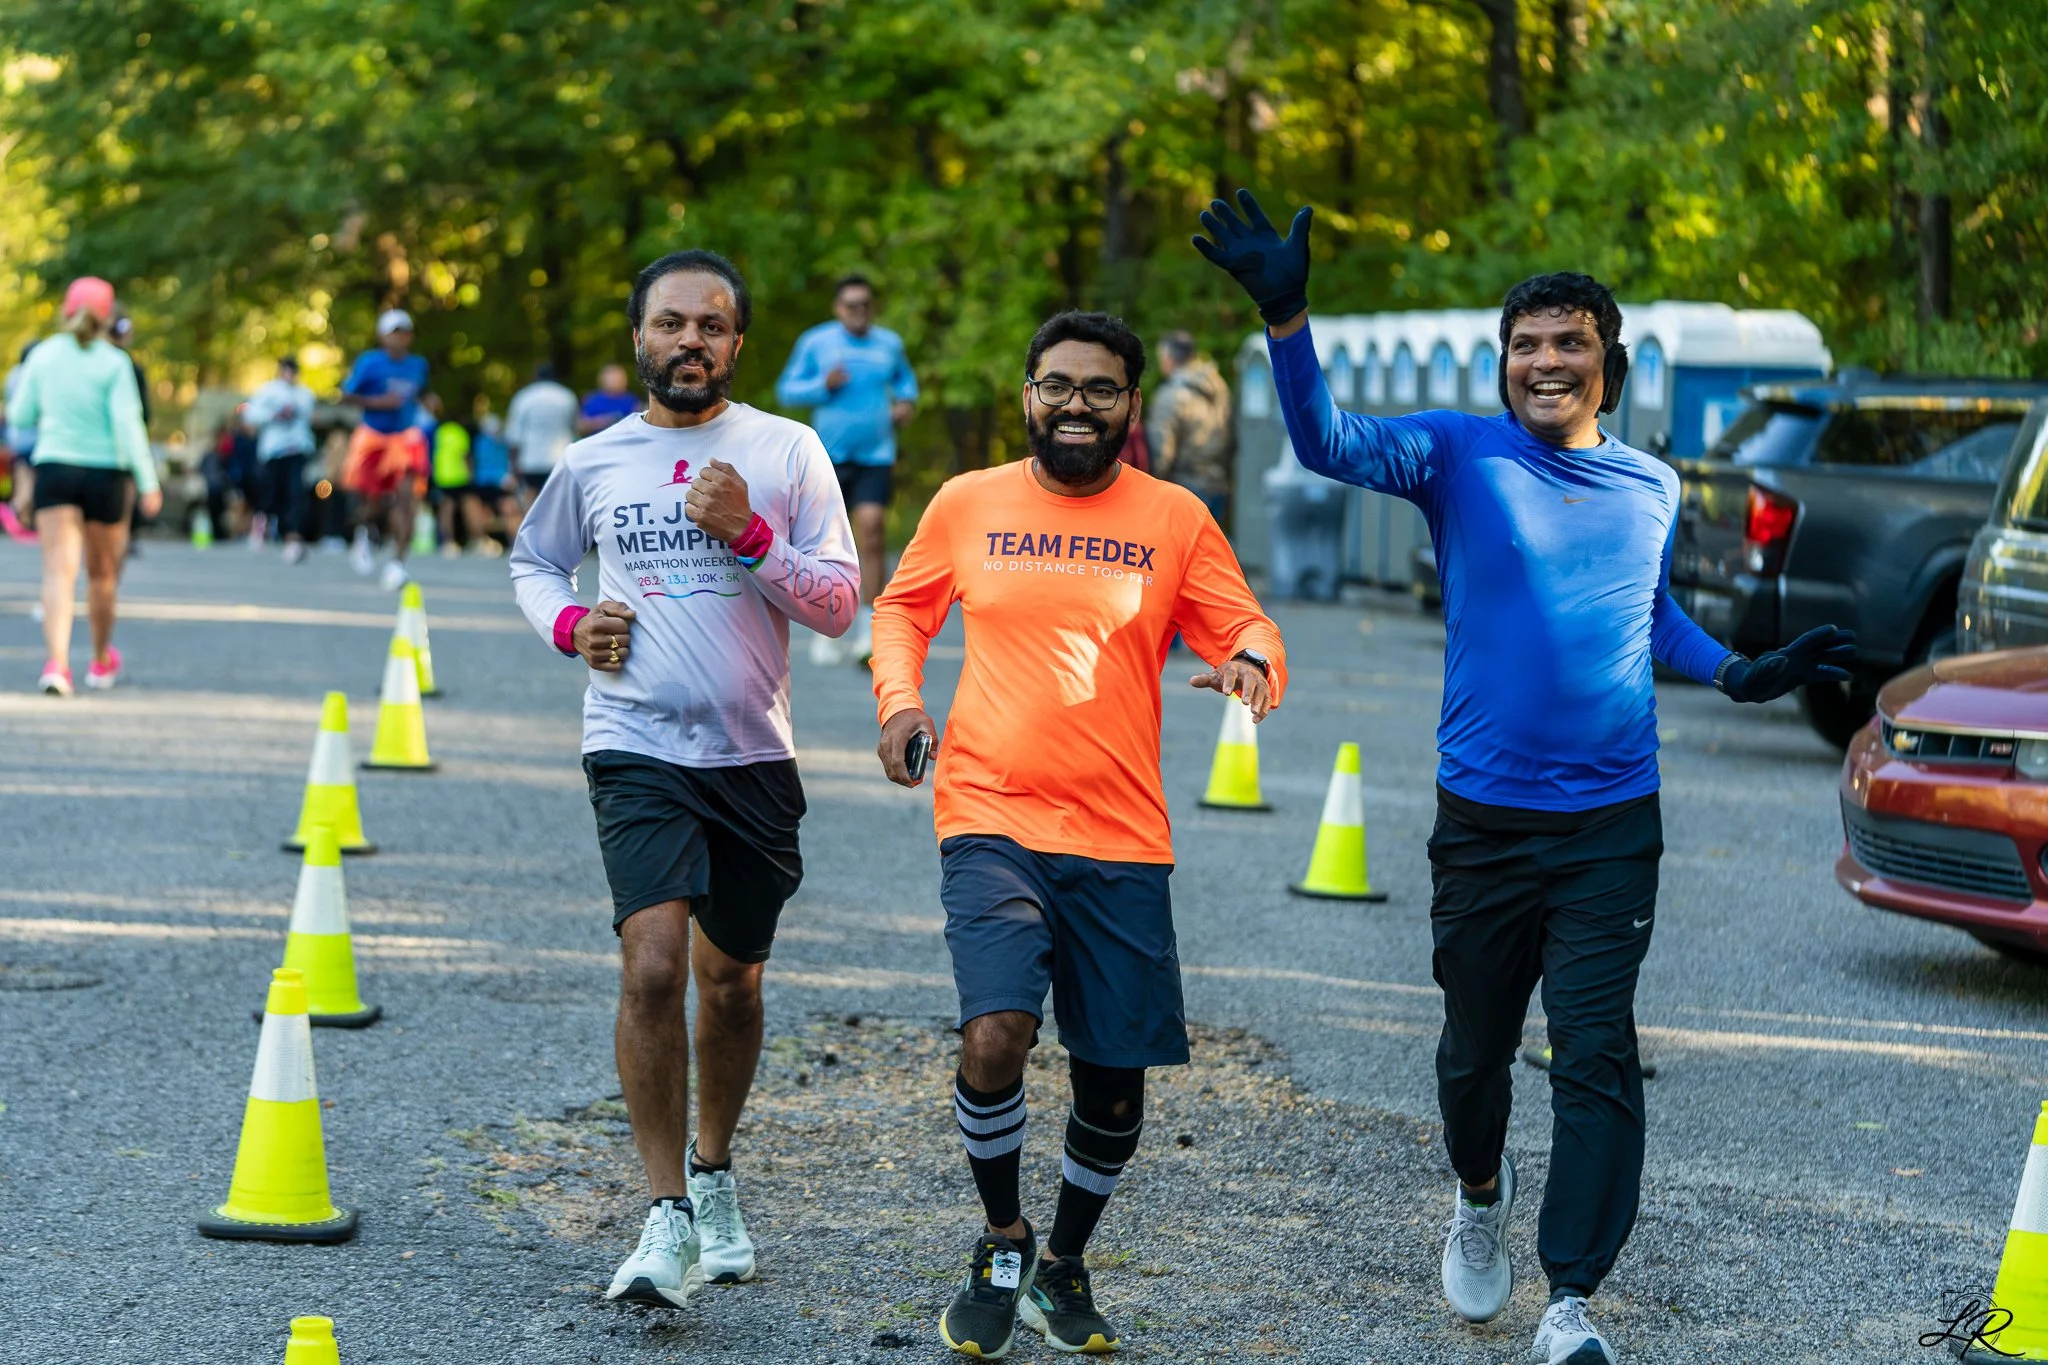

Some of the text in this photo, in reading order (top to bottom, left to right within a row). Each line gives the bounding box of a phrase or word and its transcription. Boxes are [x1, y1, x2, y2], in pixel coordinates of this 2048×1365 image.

[613, 502, 655, 529] ST.
[625, 558, 689, 572] MARATHON
[986, 532, 1156, 572] TEAM FEDEX
[638, 572, 740, 587] 26.2 13.1 10K 5K
[770, 558, 844, 616] 2025
[983, 560, 1154, 587] NO DISTANCE TOO FAR
